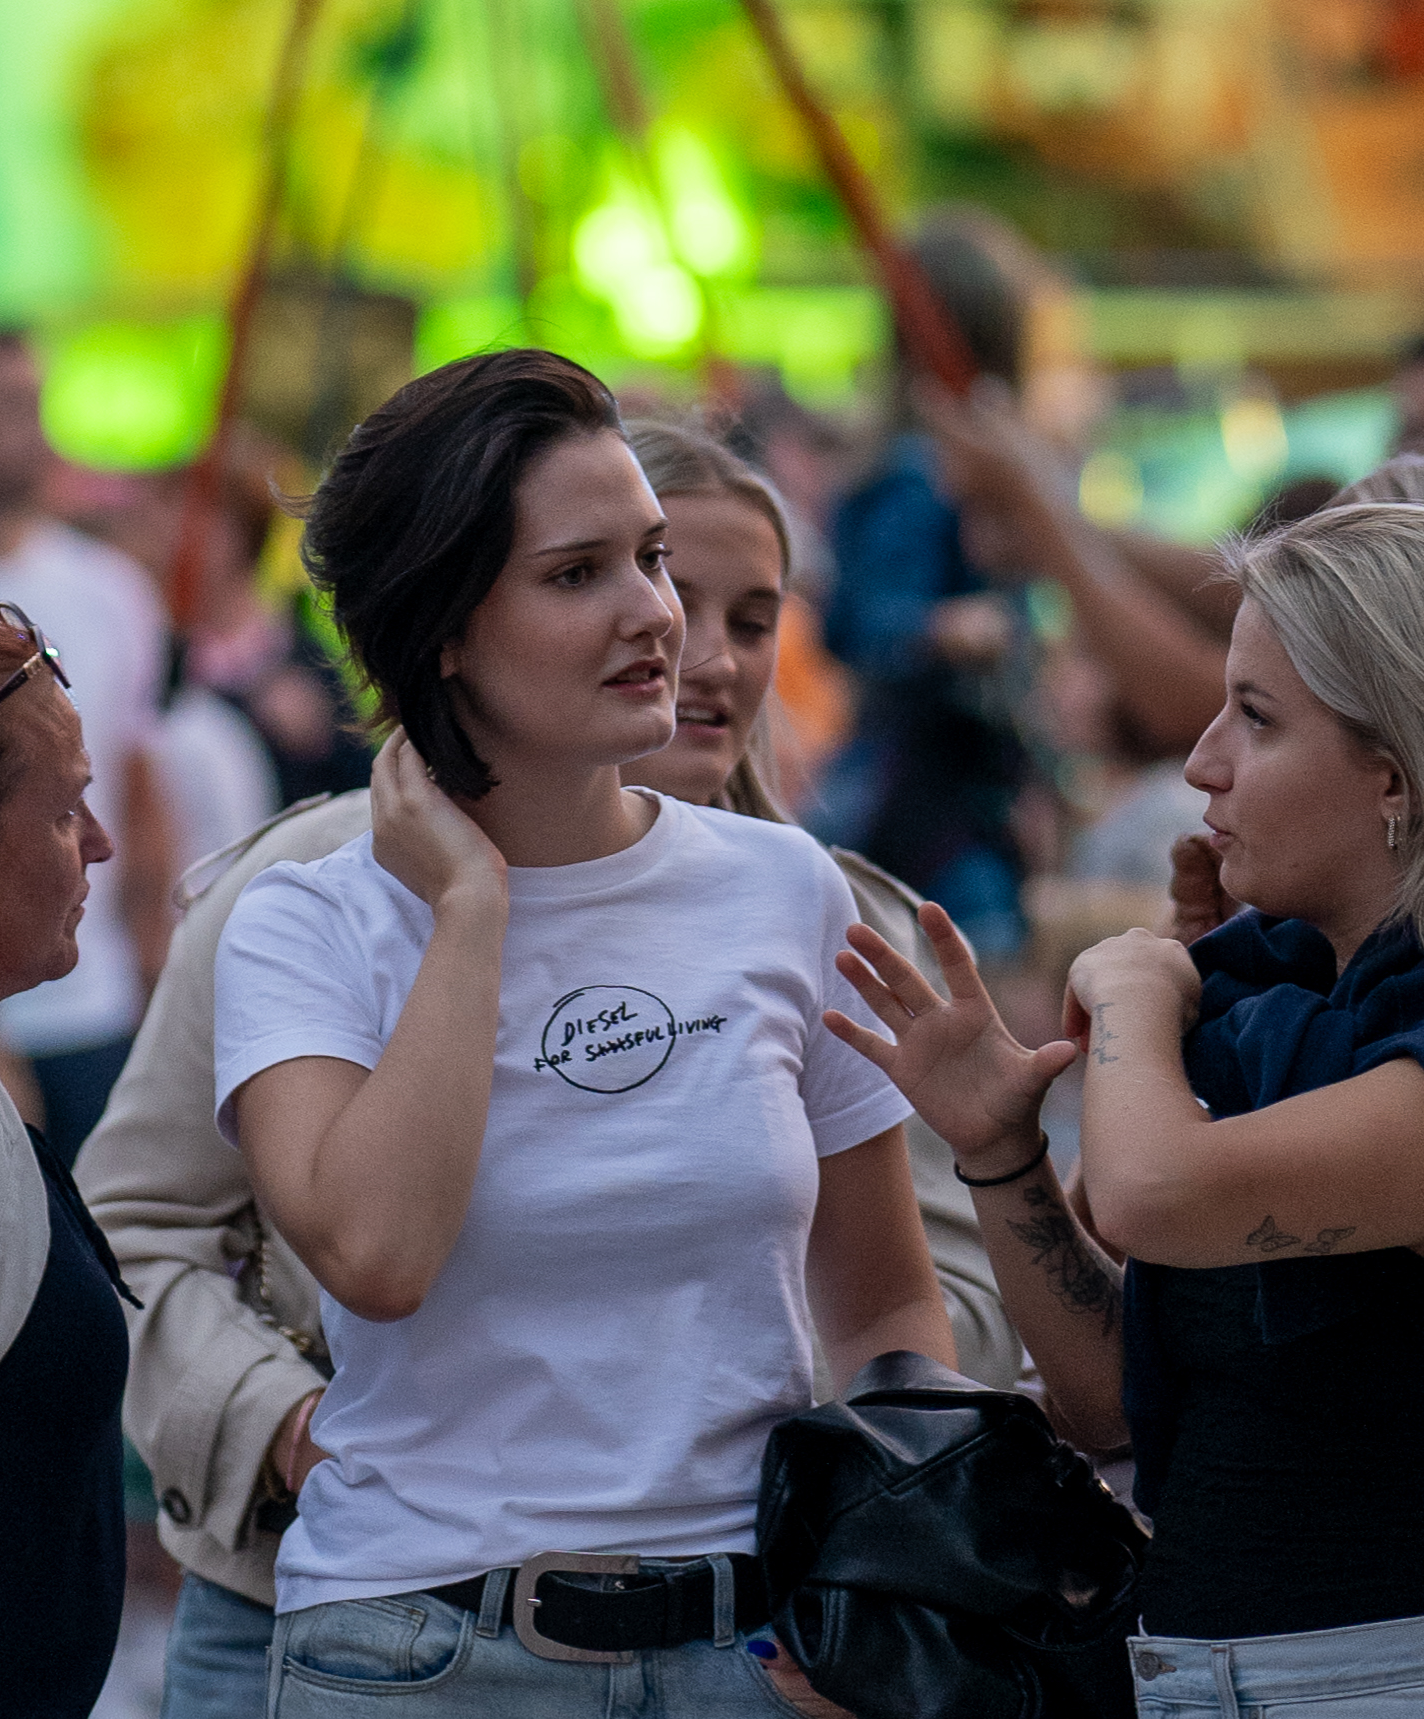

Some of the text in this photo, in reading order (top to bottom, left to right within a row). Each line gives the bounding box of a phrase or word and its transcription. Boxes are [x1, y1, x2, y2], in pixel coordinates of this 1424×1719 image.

[532, 1049, 573, 1073] FOR
[666, 1014, 728, 1036] LIVING
[561, 1000, 638, 1047] DIESEL
